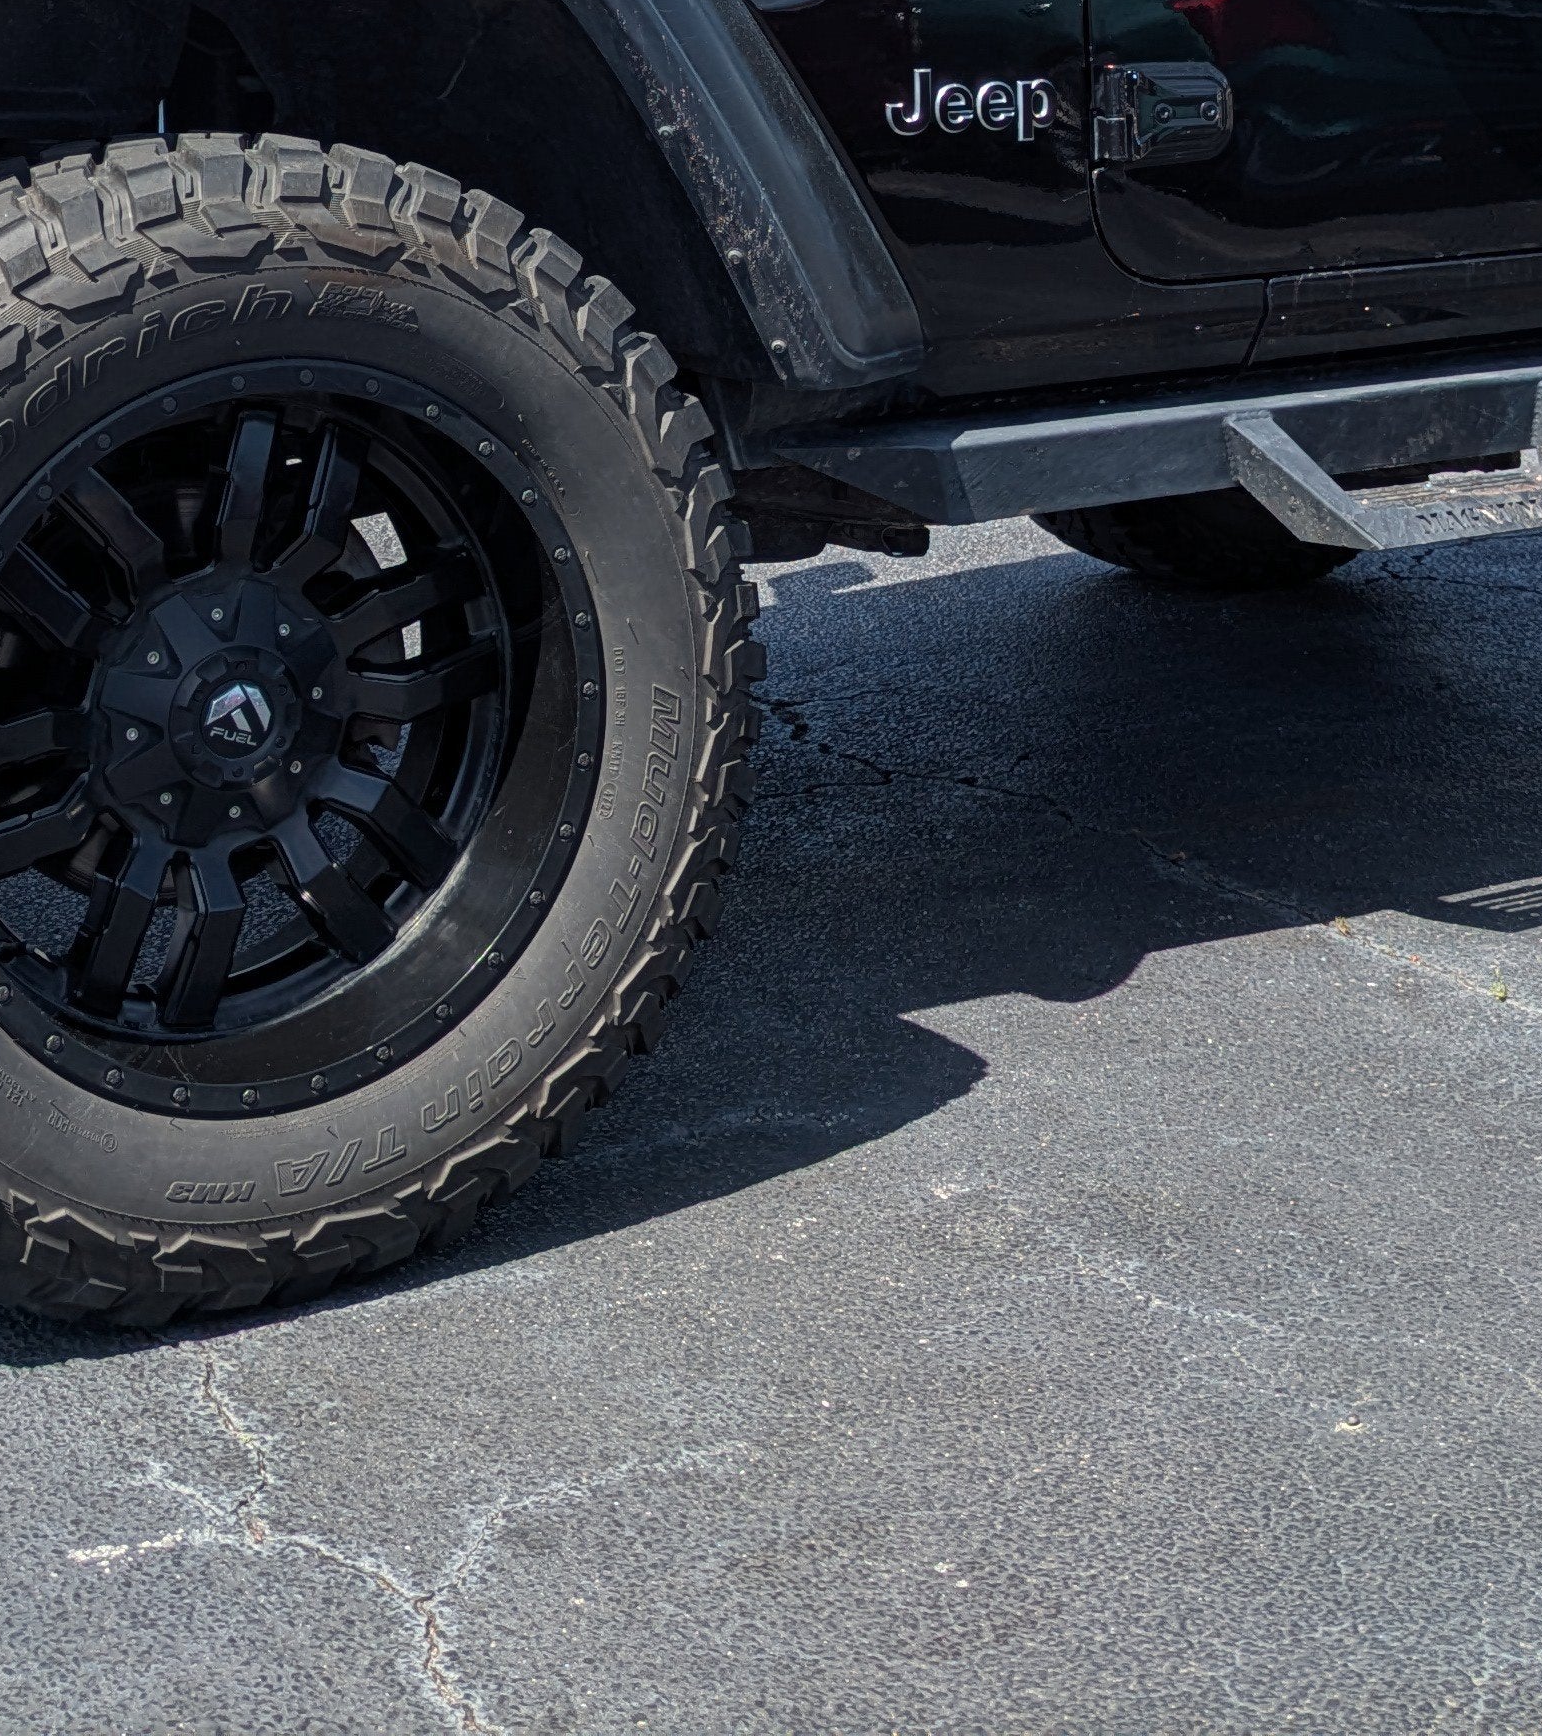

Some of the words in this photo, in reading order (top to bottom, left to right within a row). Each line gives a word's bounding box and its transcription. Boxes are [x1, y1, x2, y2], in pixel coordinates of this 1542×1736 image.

[884, 68, 1057, 142] Jeep
[210, 726, 258, 747] FUEL
[420, 683, 681, 1133] Mud-Terrain
[165, 1180, 256, 1204] KM3
[274, 1123, 407, 1196] T/A
